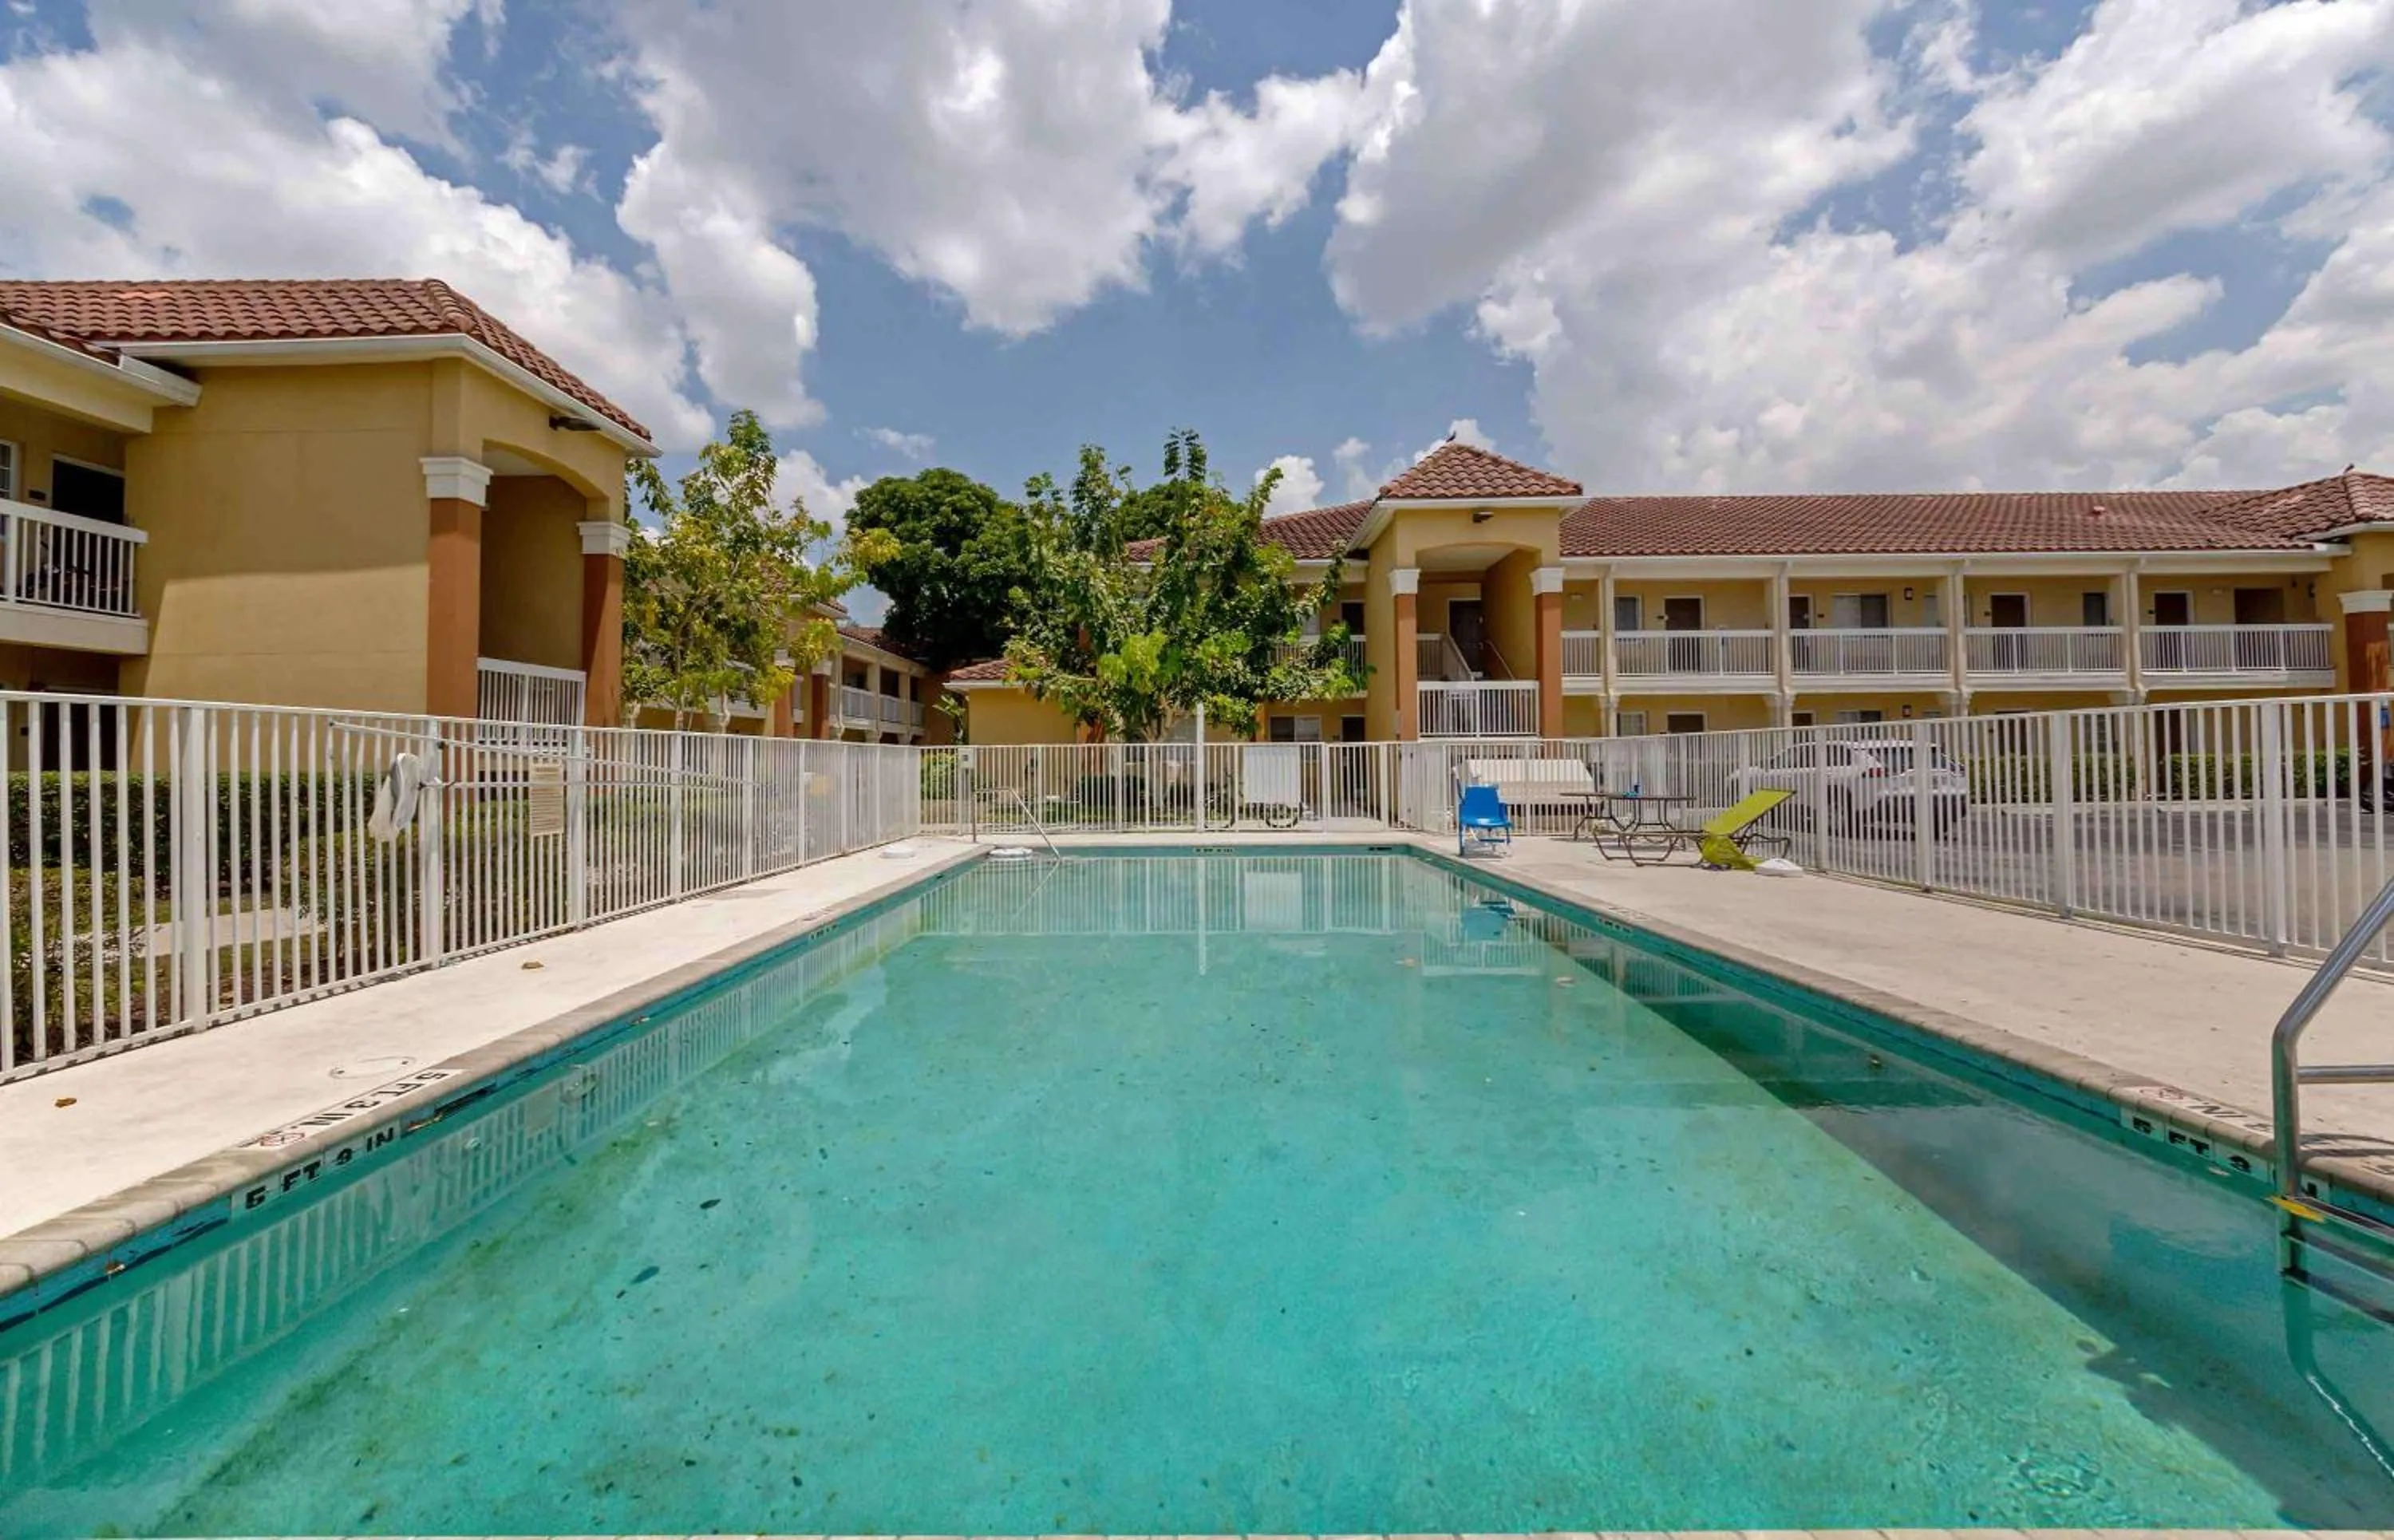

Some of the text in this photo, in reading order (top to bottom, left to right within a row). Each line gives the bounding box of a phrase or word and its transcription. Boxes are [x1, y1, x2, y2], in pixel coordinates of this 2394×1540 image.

[283, 1159, 322, 1192] FT
[366, 1127, 393, 1153] IN
[2168, 1129, 2210, 1155] FT
